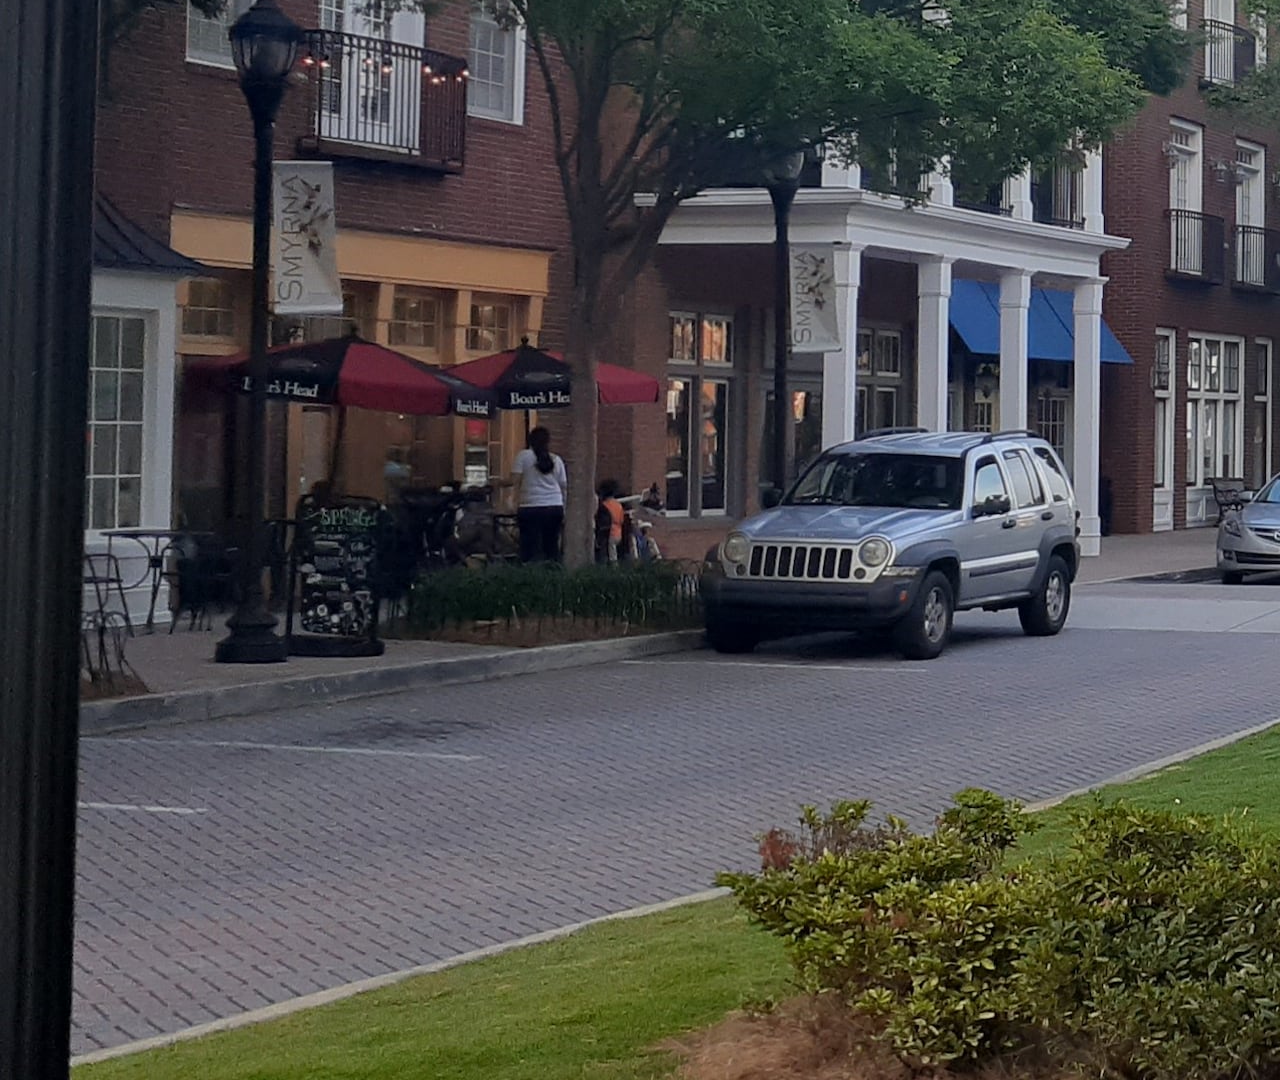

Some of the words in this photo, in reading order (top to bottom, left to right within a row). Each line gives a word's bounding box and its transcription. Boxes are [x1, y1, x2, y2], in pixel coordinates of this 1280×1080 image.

[277, 174, 303, 301] SMYRNA
[793, 250, 812, 344] SMYRNA
[283, 380, 320, 398] Head
[548, 390, 571, 404] Hea
